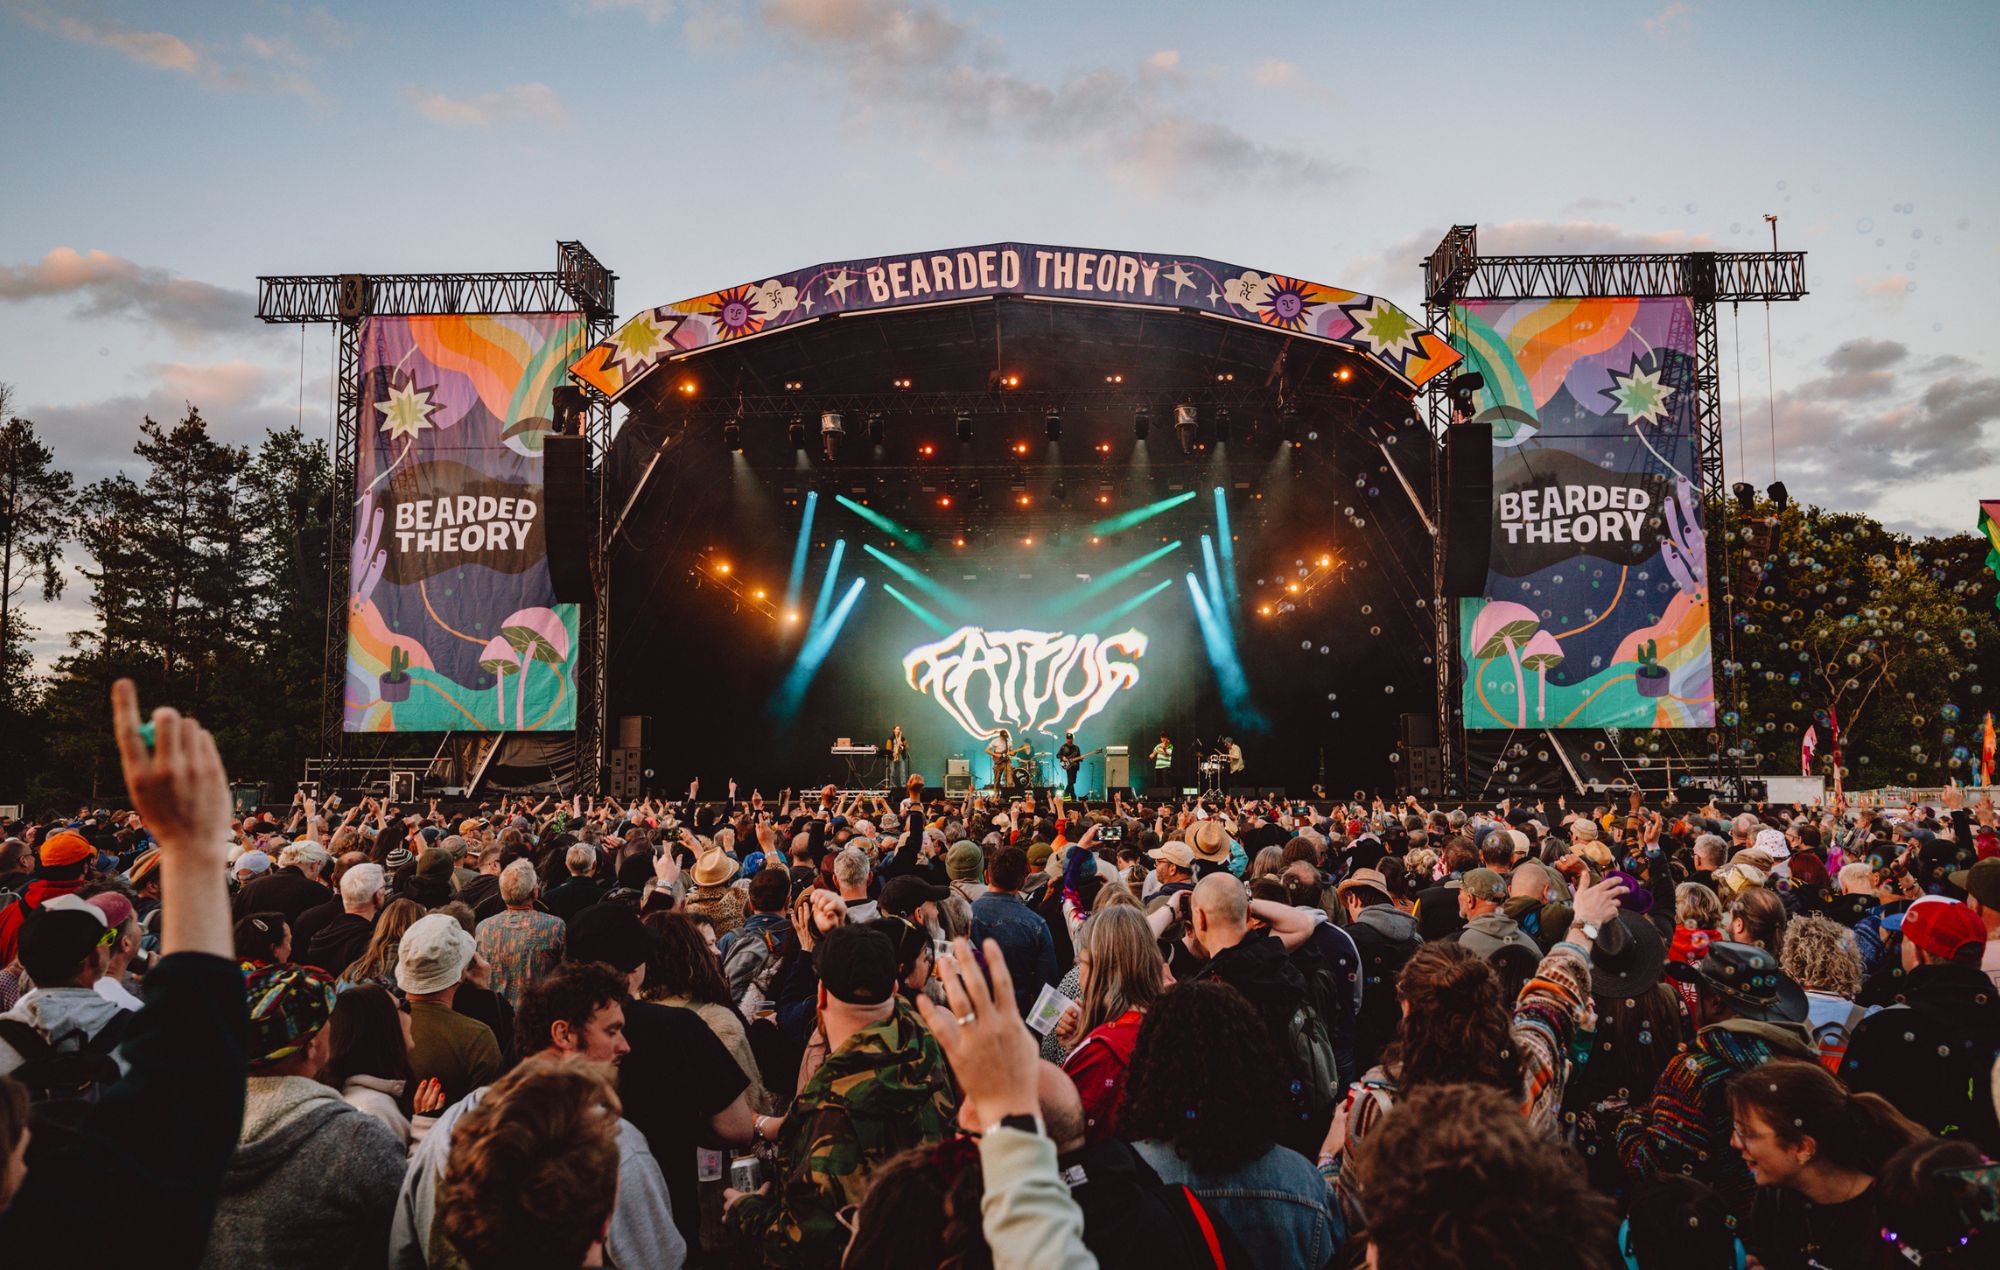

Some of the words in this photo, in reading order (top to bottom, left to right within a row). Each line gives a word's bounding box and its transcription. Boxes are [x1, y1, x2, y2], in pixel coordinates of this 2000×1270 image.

[866, 249, 1020, 303] BEARDED
[1035, 250, 1160, 297] THEORY
[395, 495, 538, 531] BEARDED
[1500, 485, 1651, 521] BEARDED
[395, 520, 532, 553] THEORY
[1501, 510, 1646, 544] THEORY
